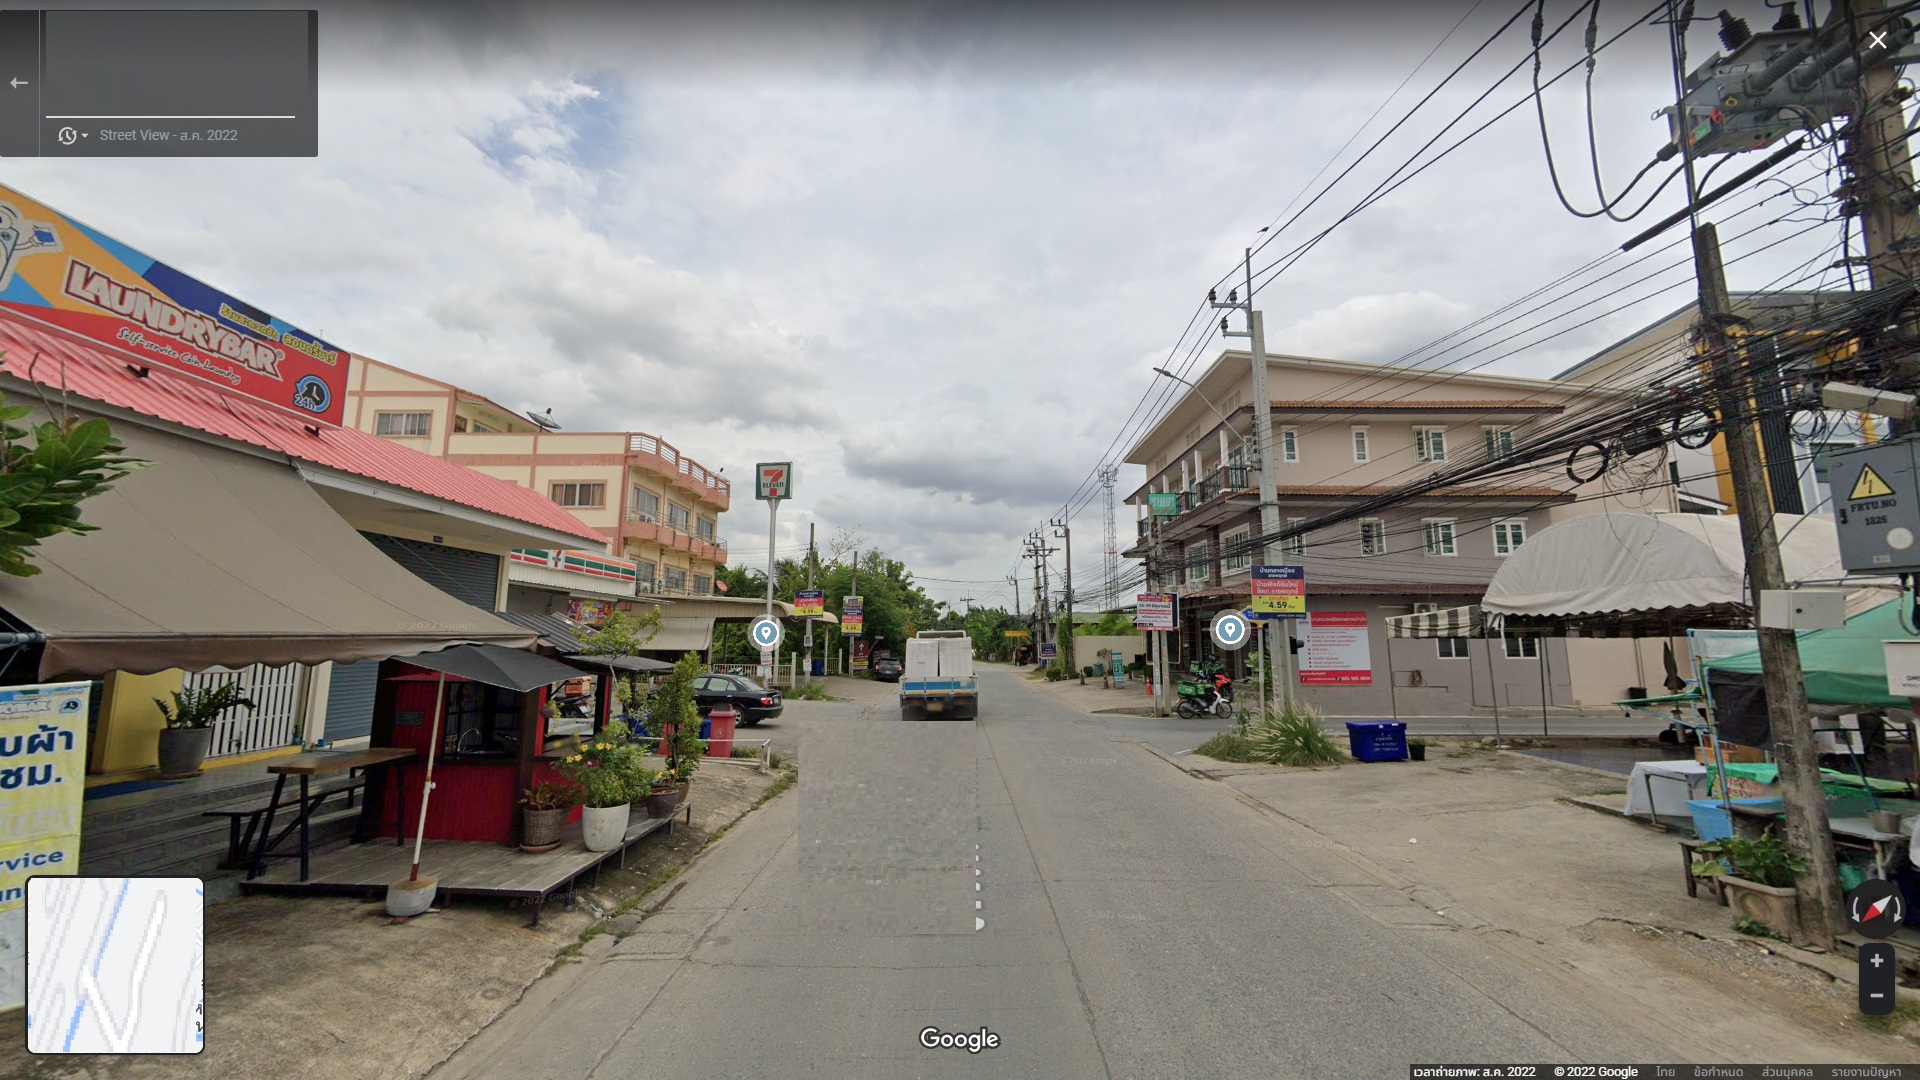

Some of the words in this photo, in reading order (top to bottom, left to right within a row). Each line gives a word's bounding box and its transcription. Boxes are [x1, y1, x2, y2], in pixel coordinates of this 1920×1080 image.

[65, 258, 281, 378] LAUNDRYBAR
[118, 328, 178, 357] Self-service
[181, 353, 201, 367] Coin
[203, 360, 240, 384] Laundry
[294, 394, 316, 409] 24h
[1268, 601, 1288, 609] 4.59
